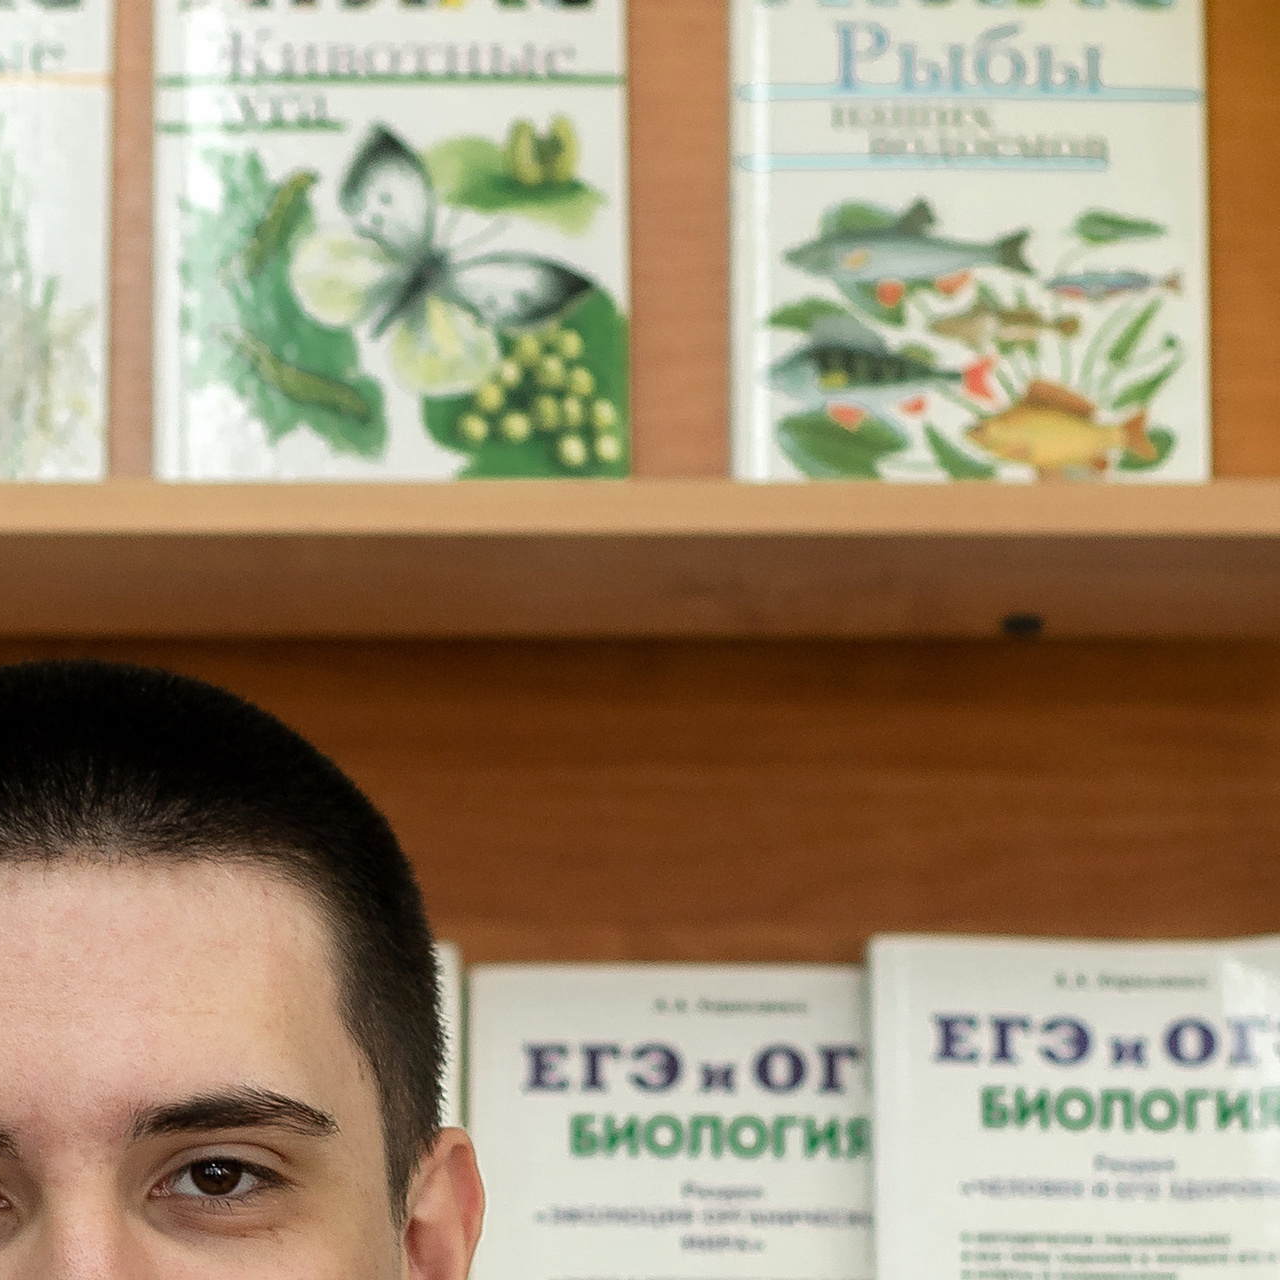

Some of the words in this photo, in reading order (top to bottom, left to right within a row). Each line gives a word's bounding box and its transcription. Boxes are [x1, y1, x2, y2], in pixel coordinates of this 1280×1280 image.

[833, 20, 1107, 93] Рыбы
[831, 105, 996, 130] наших
[932, 1014, 1092, 1066] ЕГЭ
[1110, 1035, 1147, 1067] и
[1164, 1014, 1280, 1067] ОГ
[523, 1041, 683, 1094] ЕГЭ
[699, 1062, 737, 1094] и
[980, 1085, 1280, 1132] БИОЛОГИЯ
[568, 1112, 872, 1159] БИОЛОГИЯ
